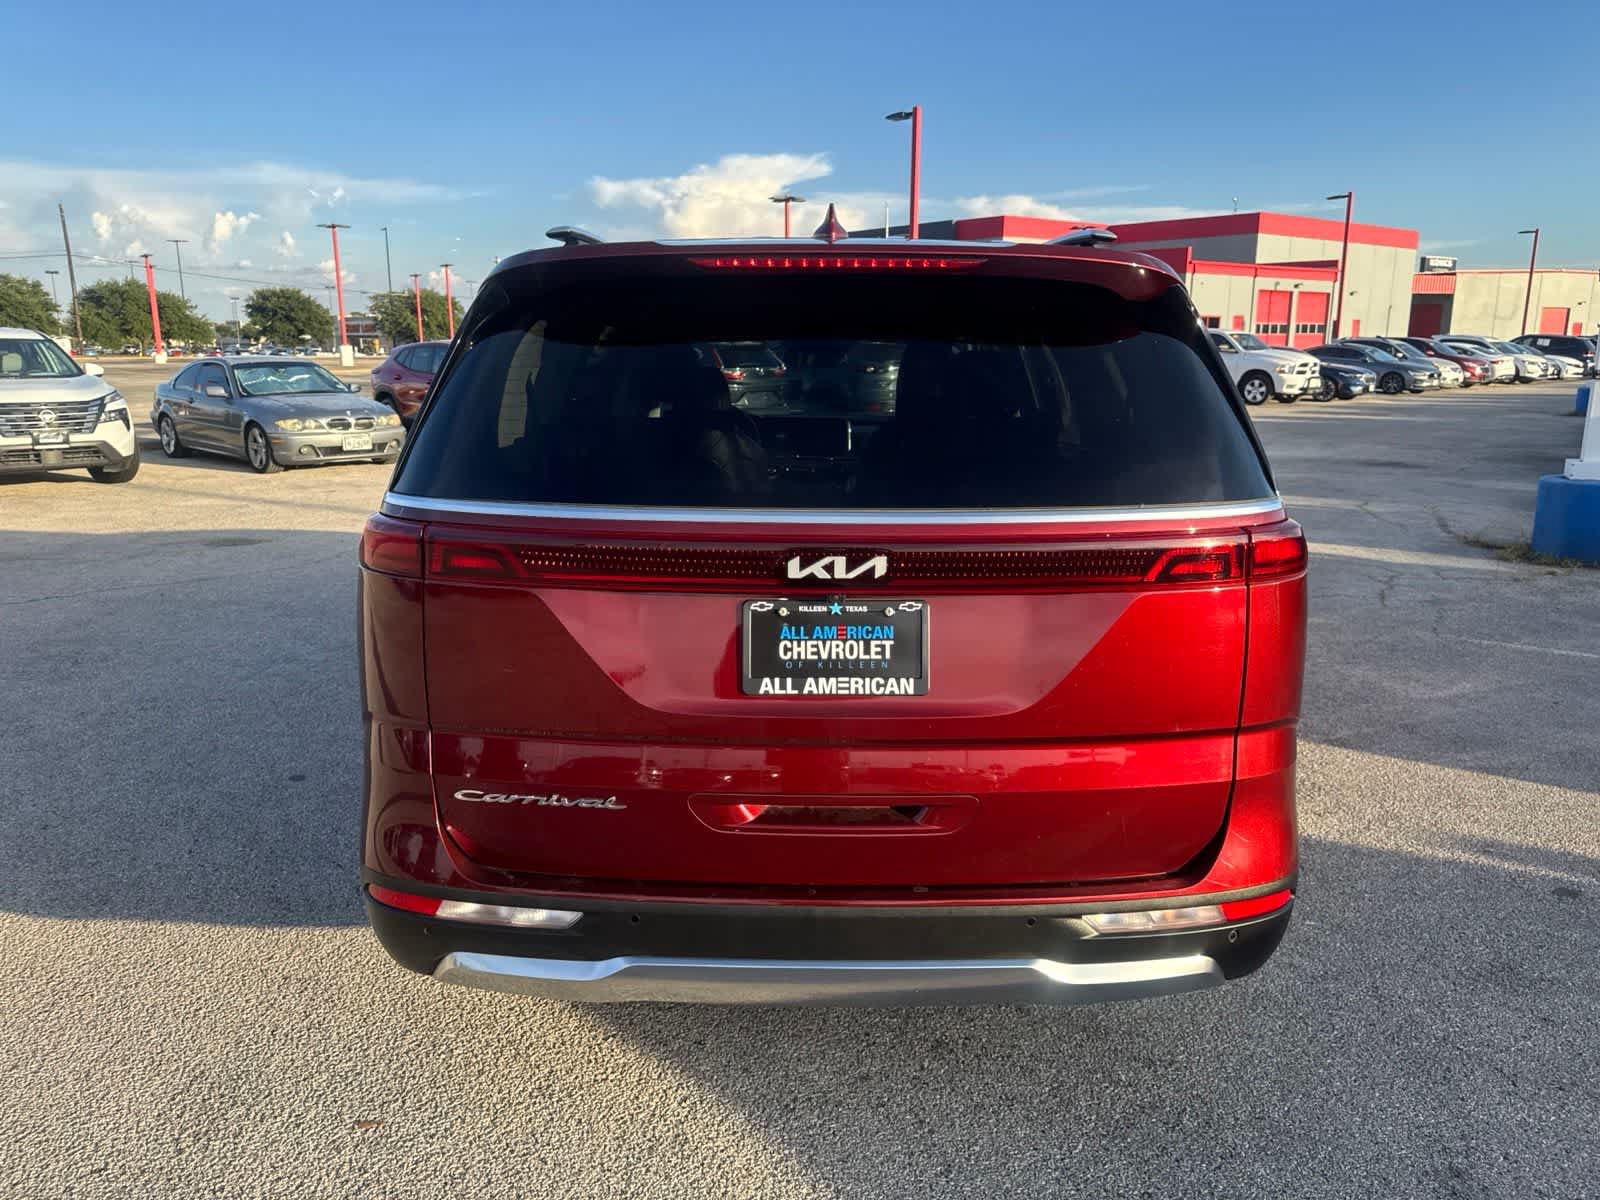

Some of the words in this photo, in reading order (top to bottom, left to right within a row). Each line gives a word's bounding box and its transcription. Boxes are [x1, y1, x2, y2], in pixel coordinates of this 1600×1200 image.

[788, 556, 887, 579] KIA
[780, 626, 808, 639] ALL
[812, 624, 894, 639] AMERICAN
[779, 641, 894, 660] CHEVROLET
[759, 678, 798, 694] ALL
[803, 677, 914, 695] AMERICAN
[454, 790, 627, 809] Carnival
